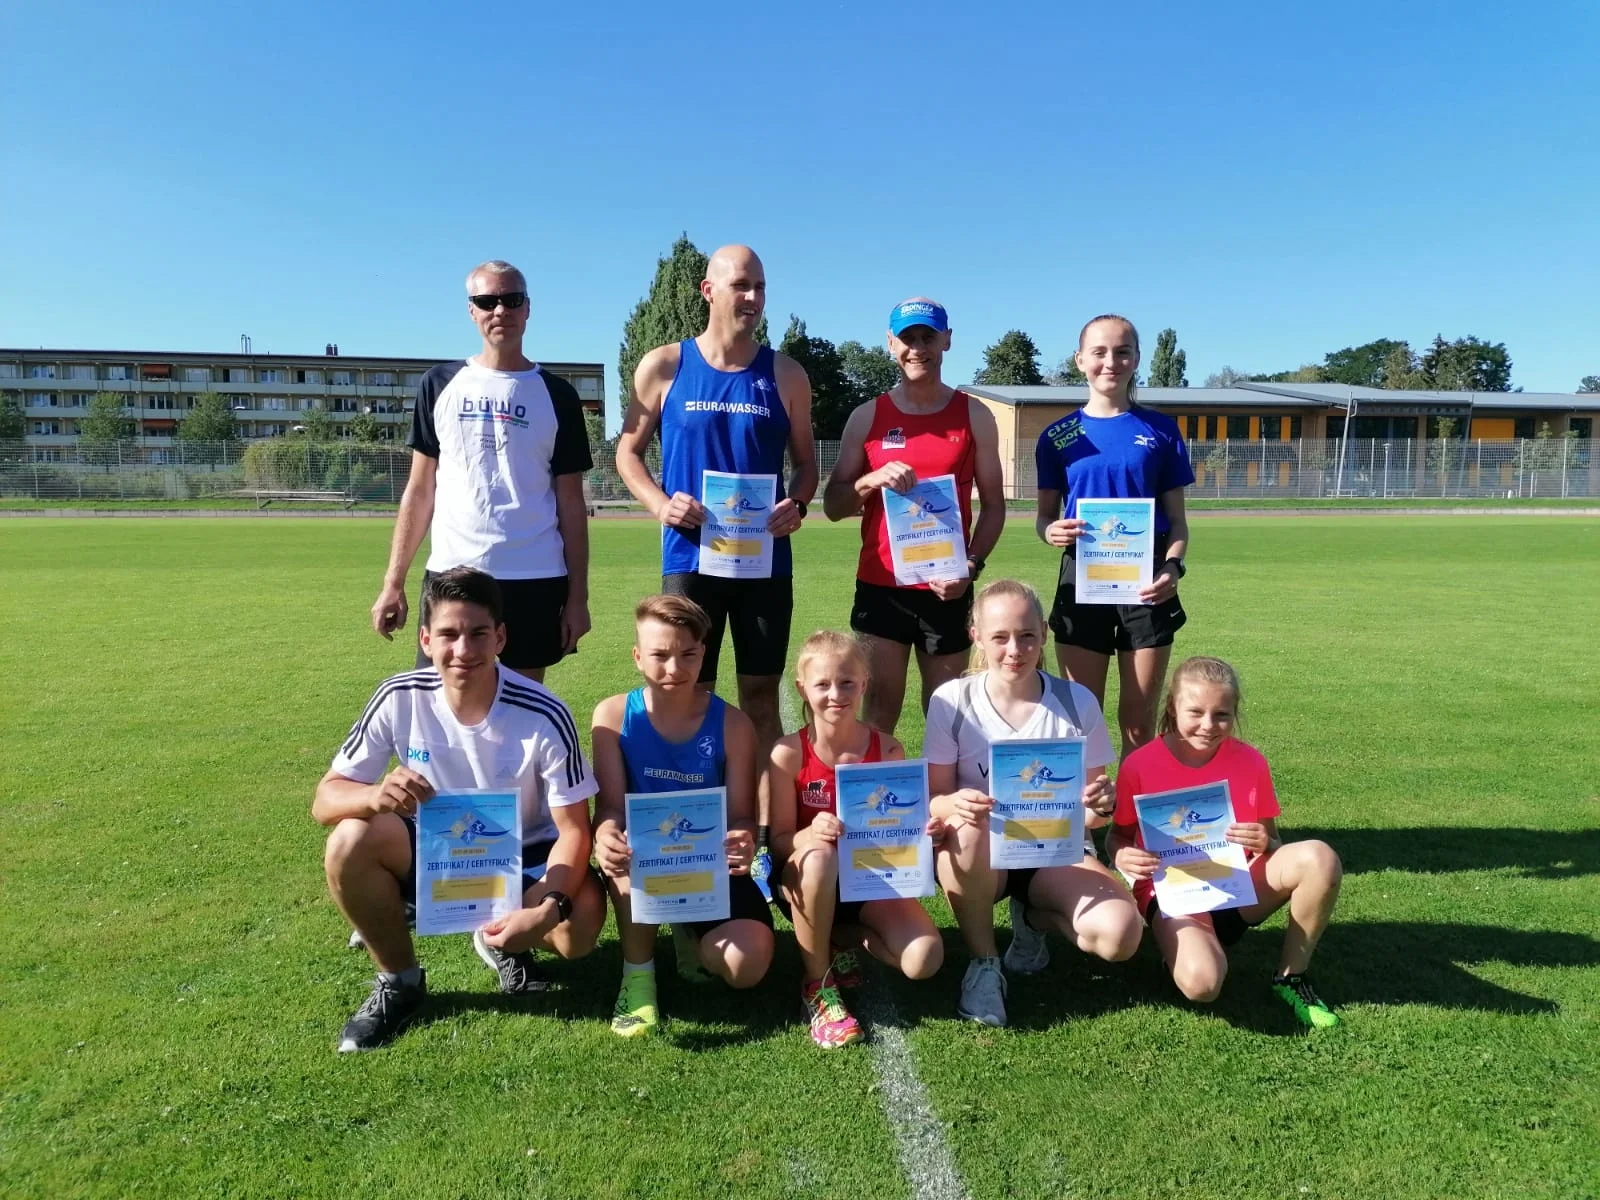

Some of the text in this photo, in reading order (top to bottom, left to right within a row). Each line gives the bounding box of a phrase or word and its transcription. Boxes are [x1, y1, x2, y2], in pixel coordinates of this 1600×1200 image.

[462, 396, 526, 418] büwo
[696, 401, 770, 418] EURAWASSER
[652, 768, 704, 783] EURAWASSER
[999, 802, 1033, 812] ZERTIFIKAT
[1039, 802, 1076, 811] CERTYFIKAT
[846, 830, 880, 840] ZERTIFIKAT
[886, 827, 921, 838] CERTYFIKAT
[1159, 846, 1189, 859] ERTIFIKAT
[427, 861, 464, 872] ZERTIFIKAT
[471, 858, 510, 869] CERTYFIKAT
[638, 857, 673, 868] ZERTIFIKAT
[679, 853, 717, 865] CERTYFIKAT
